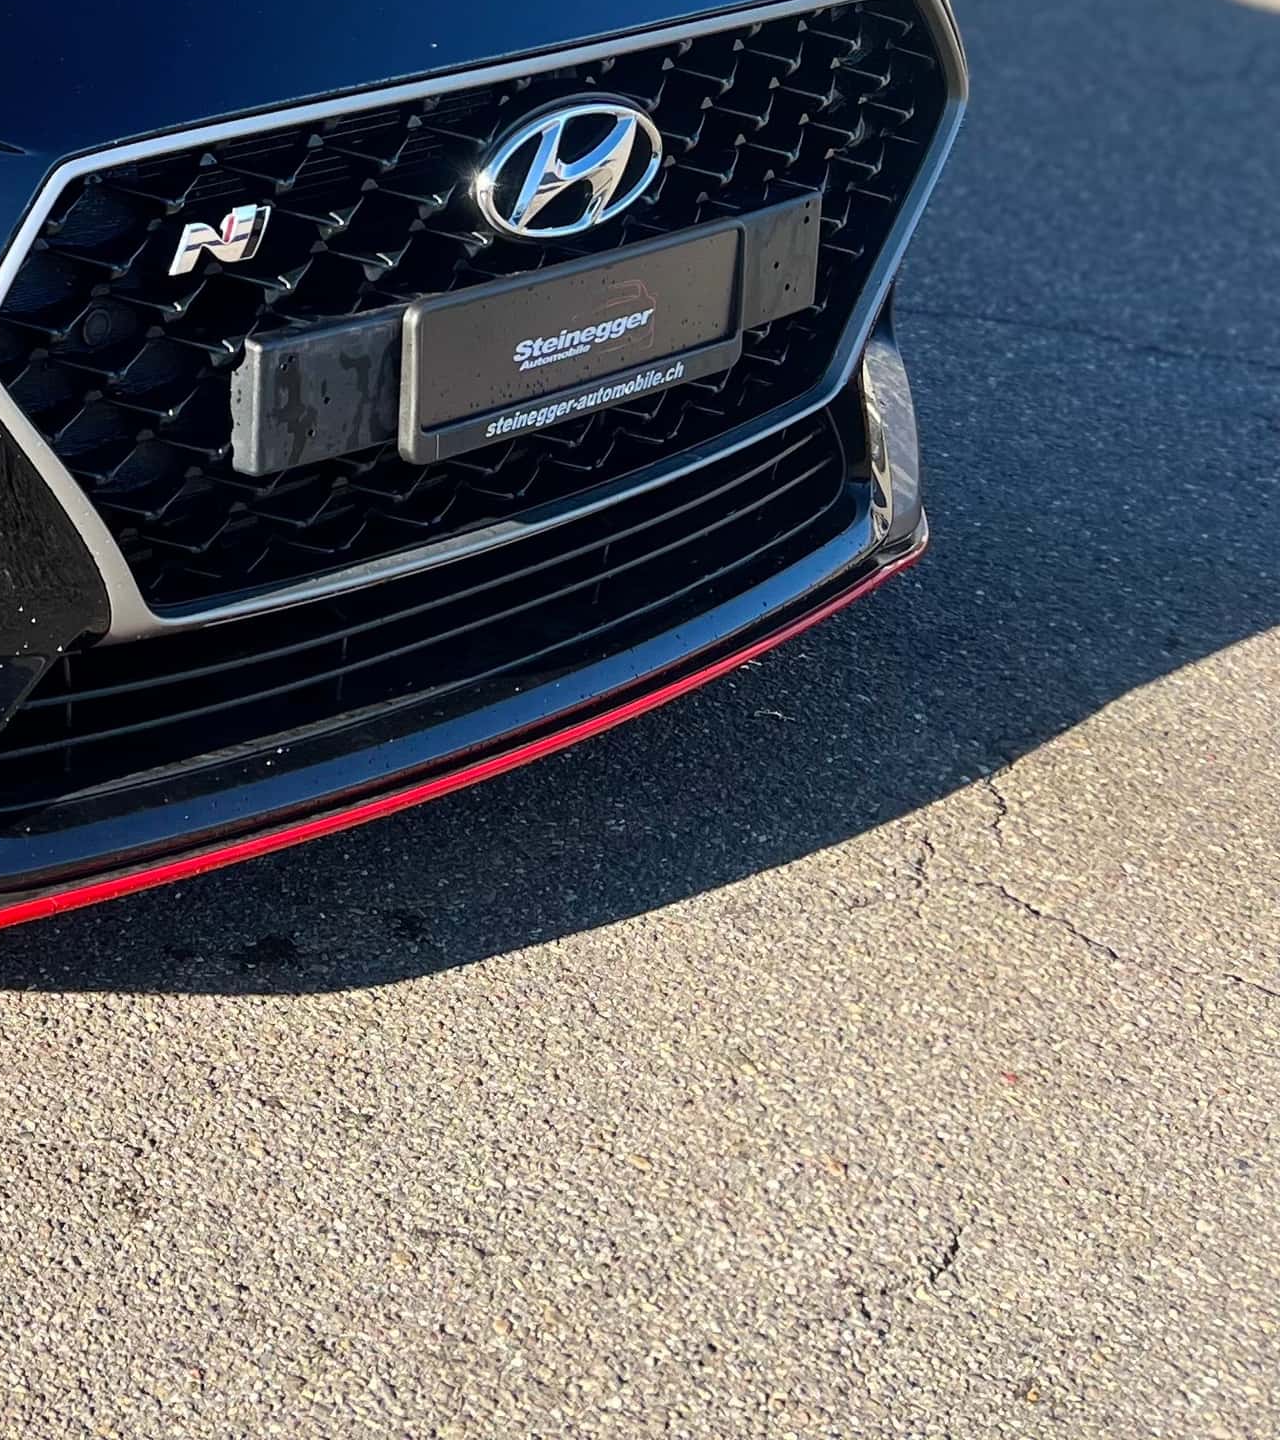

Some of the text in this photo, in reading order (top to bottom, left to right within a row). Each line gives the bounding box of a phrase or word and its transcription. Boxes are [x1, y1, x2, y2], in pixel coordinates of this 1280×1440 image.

[512, 308, 655, 362] Steinegger
[519, 344, 591, 372] Automobile
[485, 361, 685, 438] steinegger-automobile.ch
